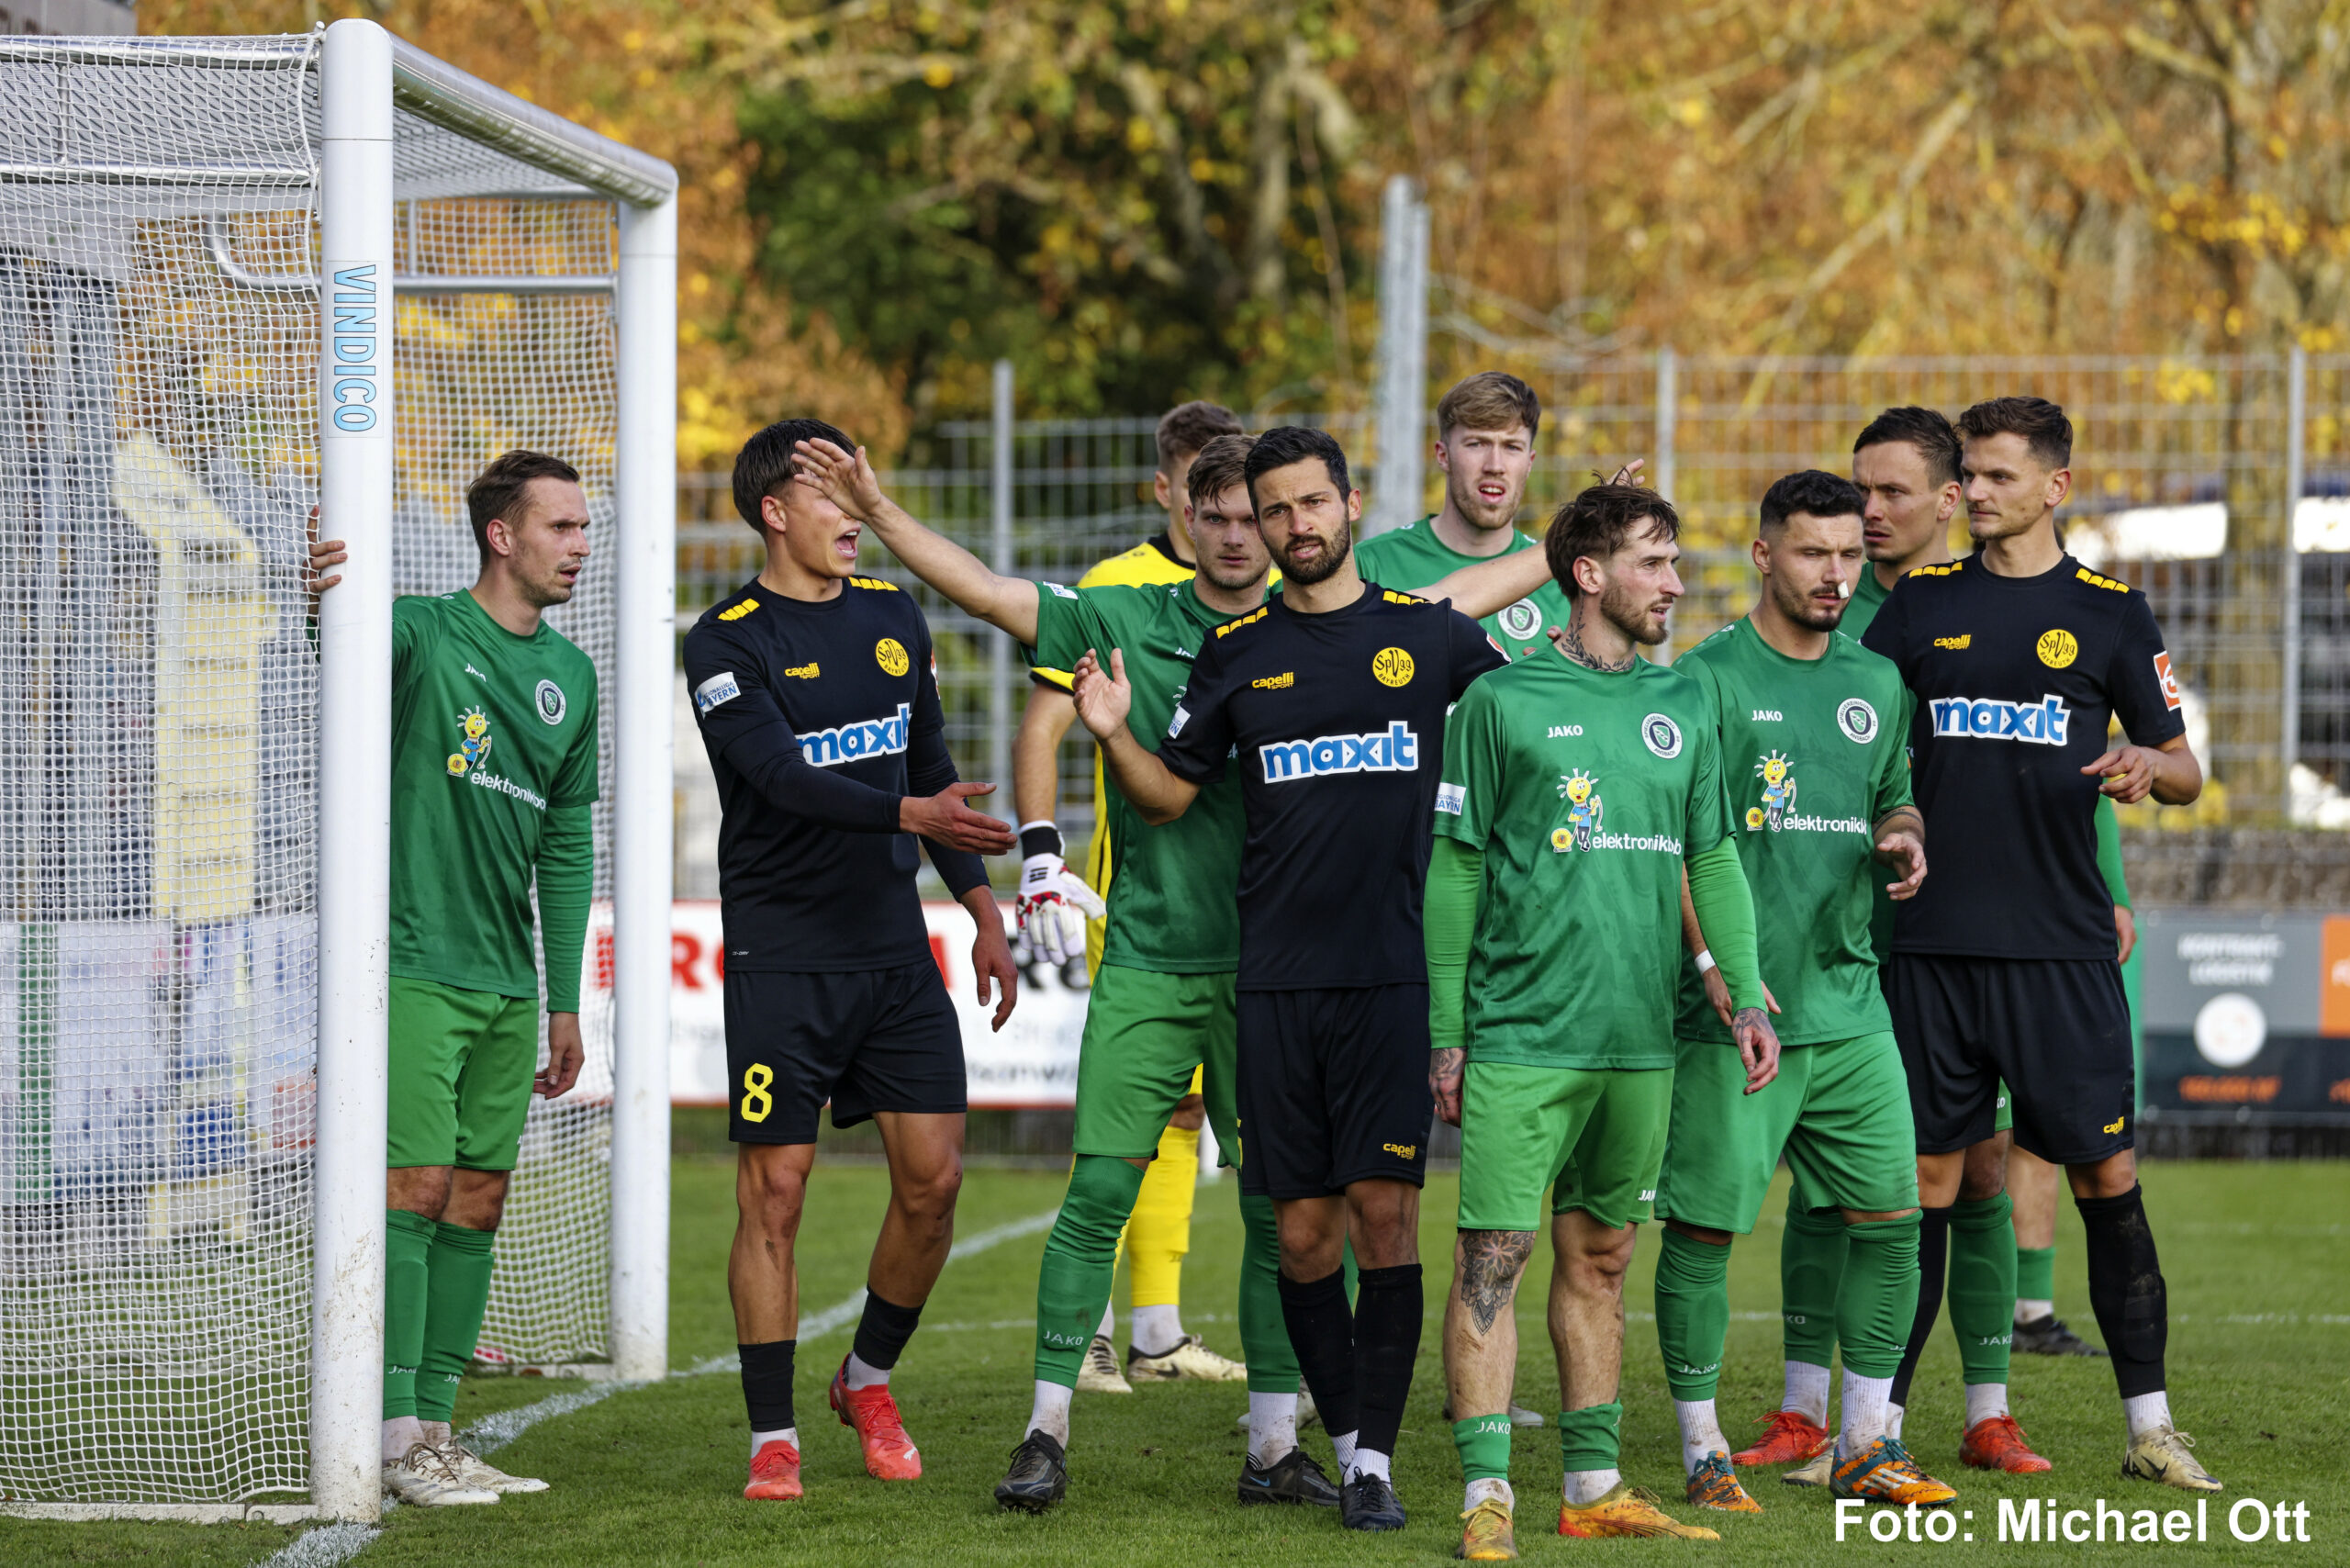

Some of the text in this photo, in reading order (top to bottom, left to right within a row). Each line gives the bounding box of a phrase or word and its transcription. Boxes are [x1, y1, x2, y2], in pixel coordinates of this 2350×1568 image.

[334, 264, 376, 431] VINDICO
[1934, 634, 1971, 649] capelli
[785, 662, 820, 678] capelli
[1375, 649, 1412, 678] SpVgg
[1252, 671, 1293, 689] capelli
[1378, 673, 1410, 685] BAYREUTH
[1751, 710, 1783, 722] JAKO
[1932, 698, 2067, 743] maxit
[797, 705, 912, 764] maxit
[1548, 725, 1583, 738] JAKO
[1262, 722, 1416, 781] maxit
[741, 1062, 774, 1124] 8
[1042, 1329, 1084, 1346] JAKO
[1475, 1420, 1511, 1434] JAKO
